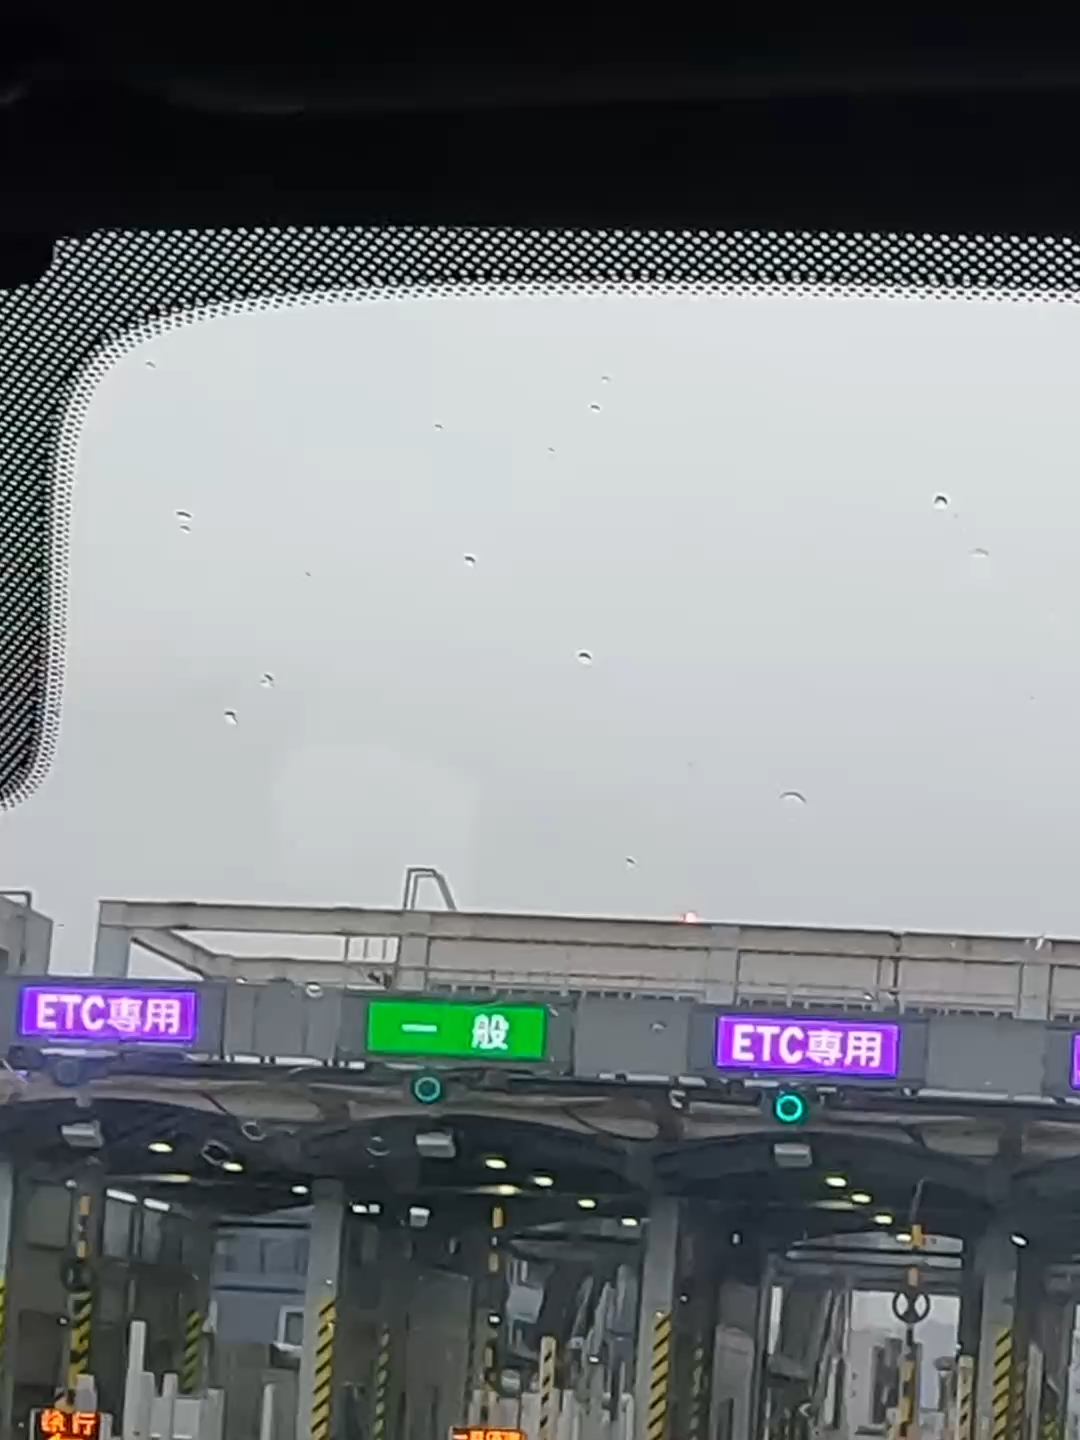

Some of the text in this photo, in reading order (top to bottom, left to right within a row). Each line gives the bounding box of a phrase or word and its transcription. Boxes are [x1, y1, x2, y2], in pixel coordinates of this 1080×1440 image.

[36, 993, 182, 1034] ETC専用
[402, 1013, 509, 1051] 一般
[731, 1024, 883, 1068] ETC専用
